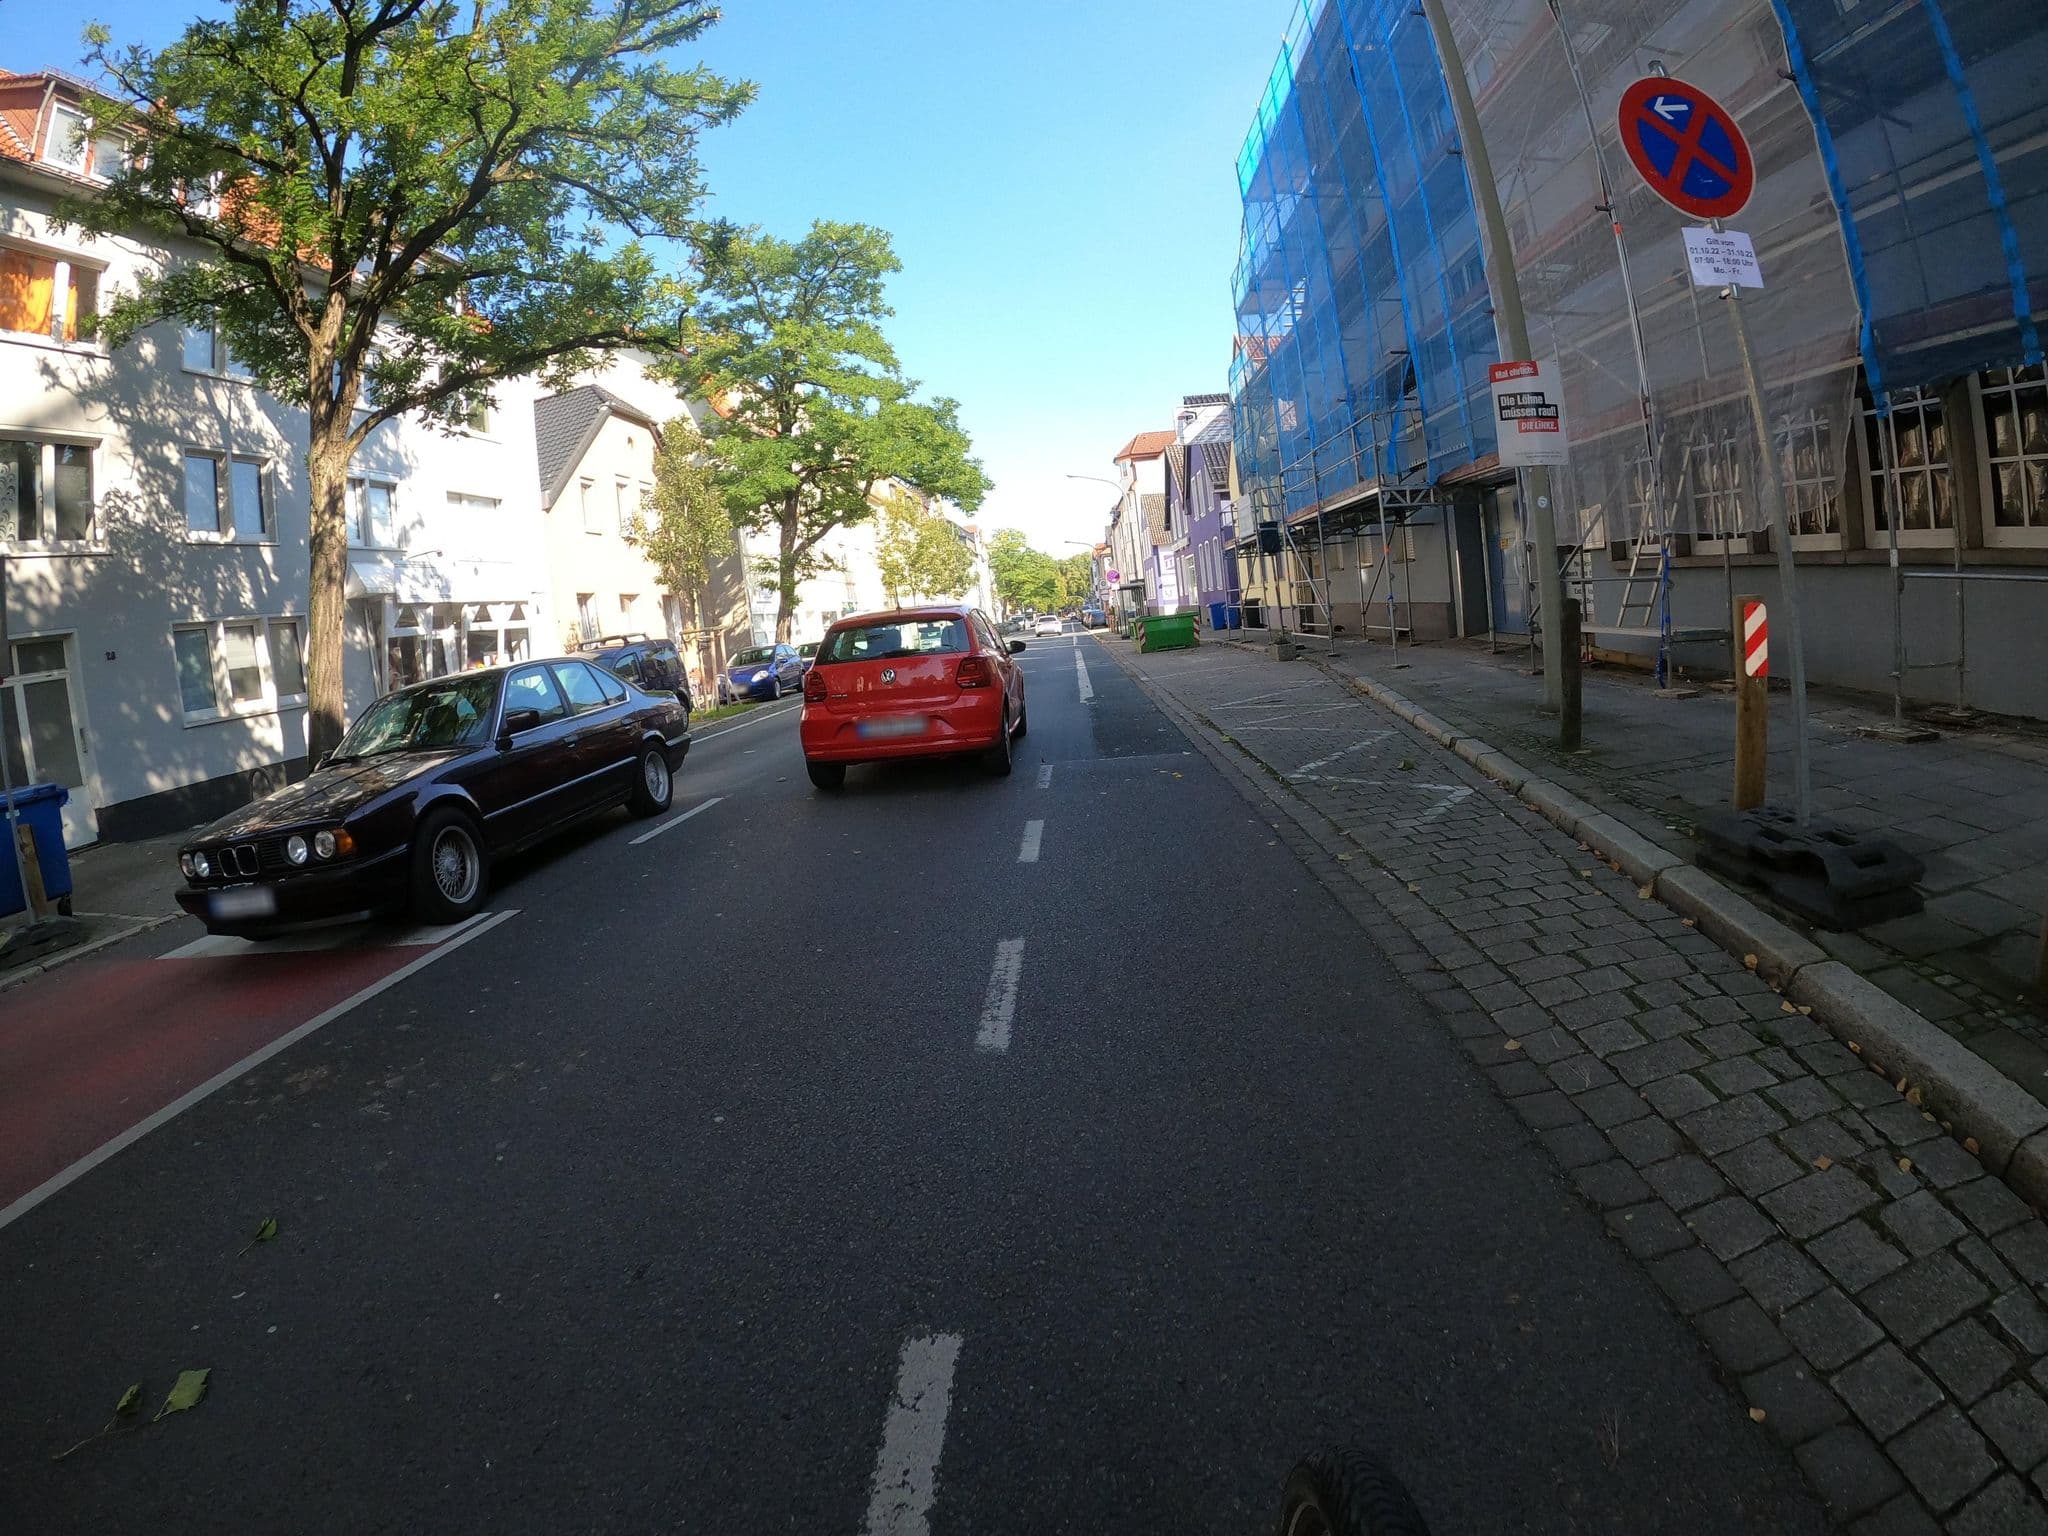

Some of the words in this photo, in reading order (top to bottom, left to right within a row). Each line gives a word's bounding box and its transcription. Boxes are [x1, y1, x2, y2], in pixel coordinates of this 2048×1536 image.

[1500, 395, 1515, 407] Die
[1517, 394, 1544, 405] Löhne
[1502, 406, 1537, 419] müssen
[1521, 421, 1534, 431] DIE
